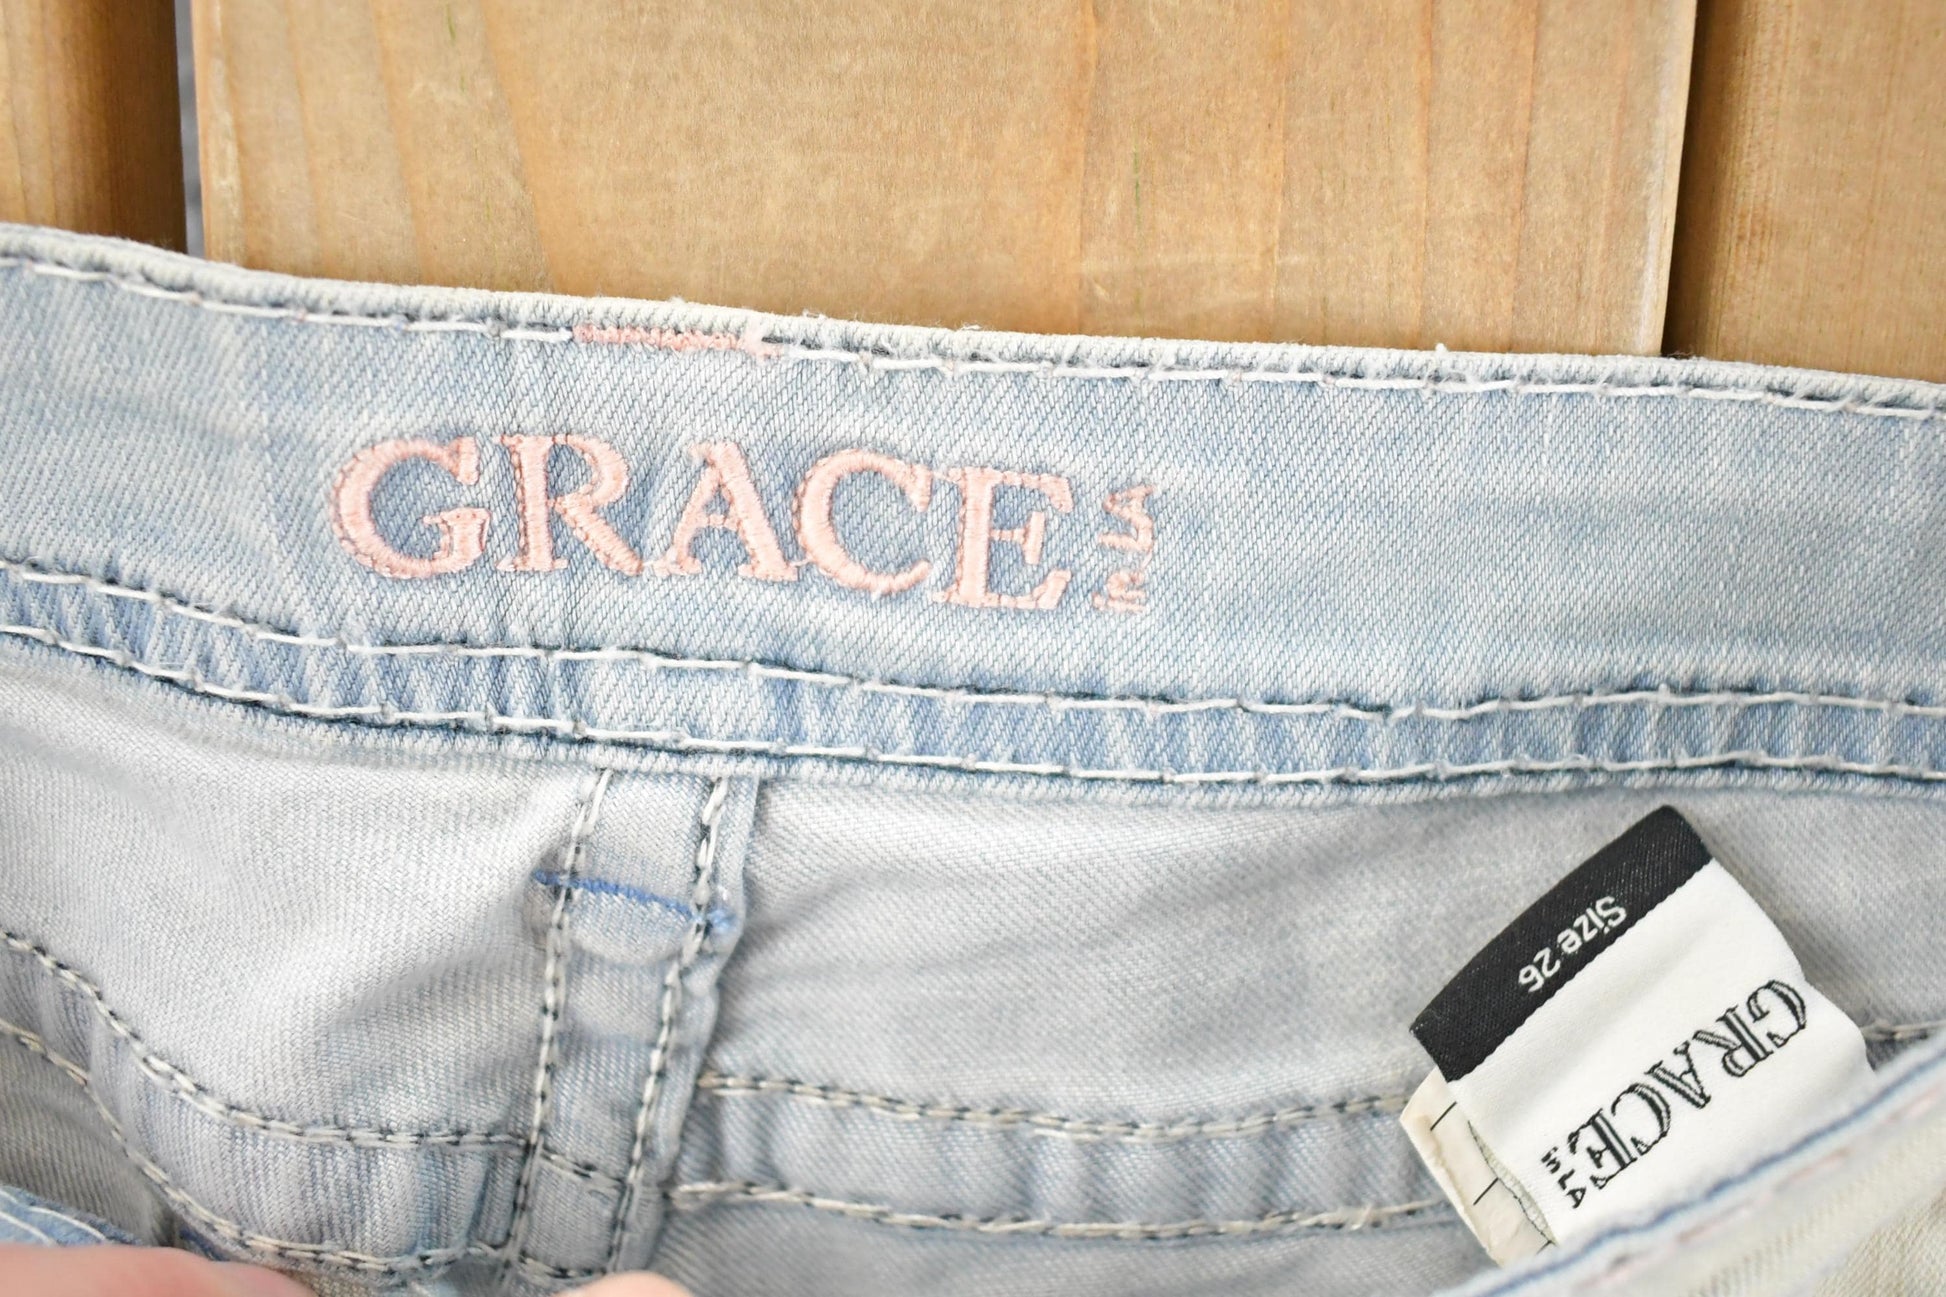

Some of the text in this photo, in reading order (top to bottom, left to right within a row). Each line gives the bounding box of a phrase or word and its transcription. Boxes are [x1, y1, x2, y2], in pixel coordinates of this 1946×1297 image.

[330, 432, 1073, 612] GRACE
[1097, 484, 1155, 554] LA
[1517, 895, 1628, 993] Size 26
[1568, 979, 1808, 1190] GRACE
[1541, 1146, 1587, 1209] in LA
